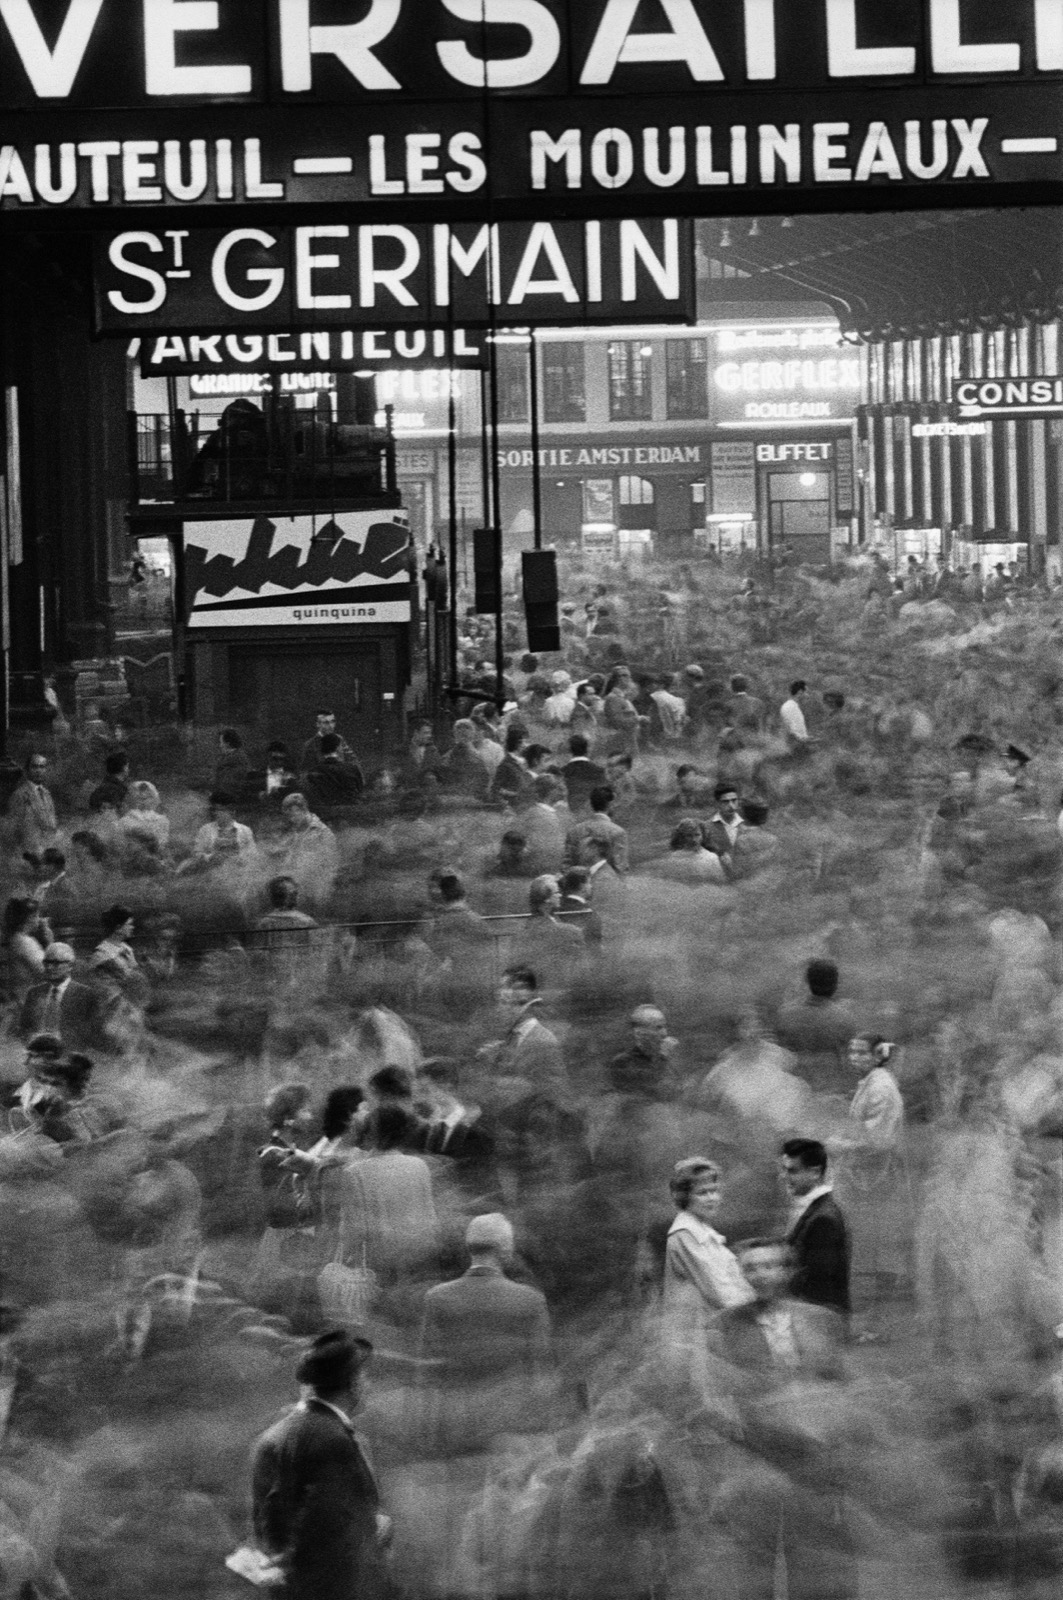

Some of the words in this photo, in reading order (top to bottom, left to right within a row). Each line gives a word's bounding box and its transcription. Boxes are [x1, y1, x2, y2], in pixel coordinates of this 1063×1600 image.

[0, 0, 1063, 98] VERSAILL
[0, 138, 284, 204] AUTEUIL
[368, 131, 487, 195] LES
[530, 117, 991, 190] MOULINEAUX
[211, 217, 680, 312] GERMAIN
[713, 360, 861, 392] GERFLEX
[957, 380, 1063, 406] CONSI
[745, 402, 832, 418] ROULEAUX
[496, 449, 573, 468] SORTIE
[576, 446, 701, 466] AMSTERDAM
[756, 442, 832, 462] BUFFET
[293, 606, 377, 621] quinquina
